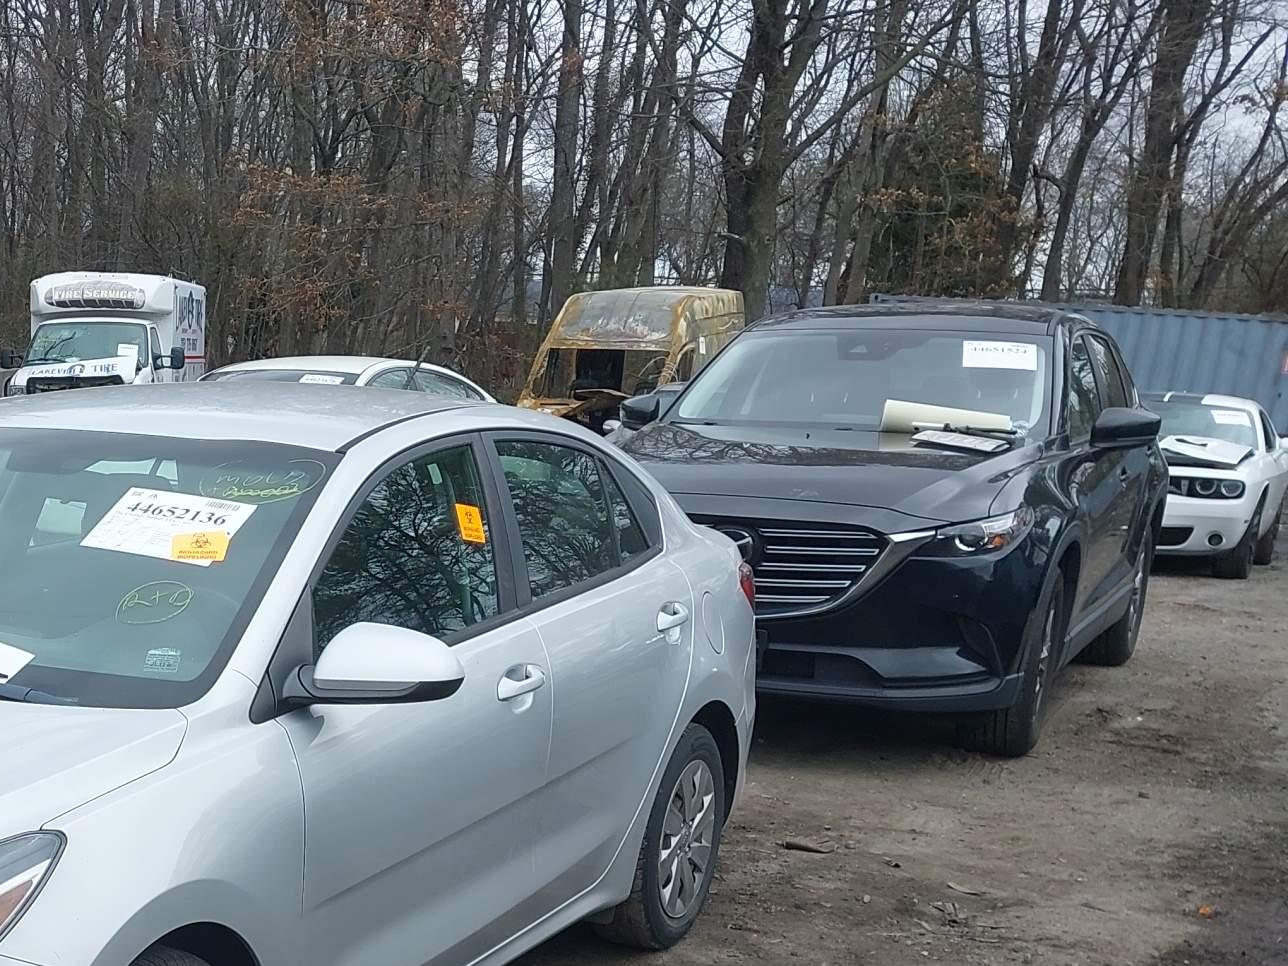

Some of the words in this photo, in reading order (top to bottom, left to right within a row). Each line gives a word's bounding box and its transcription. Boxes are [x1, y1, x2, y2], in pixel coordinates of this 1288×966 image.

[55, 288, 81, 300] TIRE
[83, 288, 136, 300] SERVICE
[127, 501, 232, 526] 44652136
